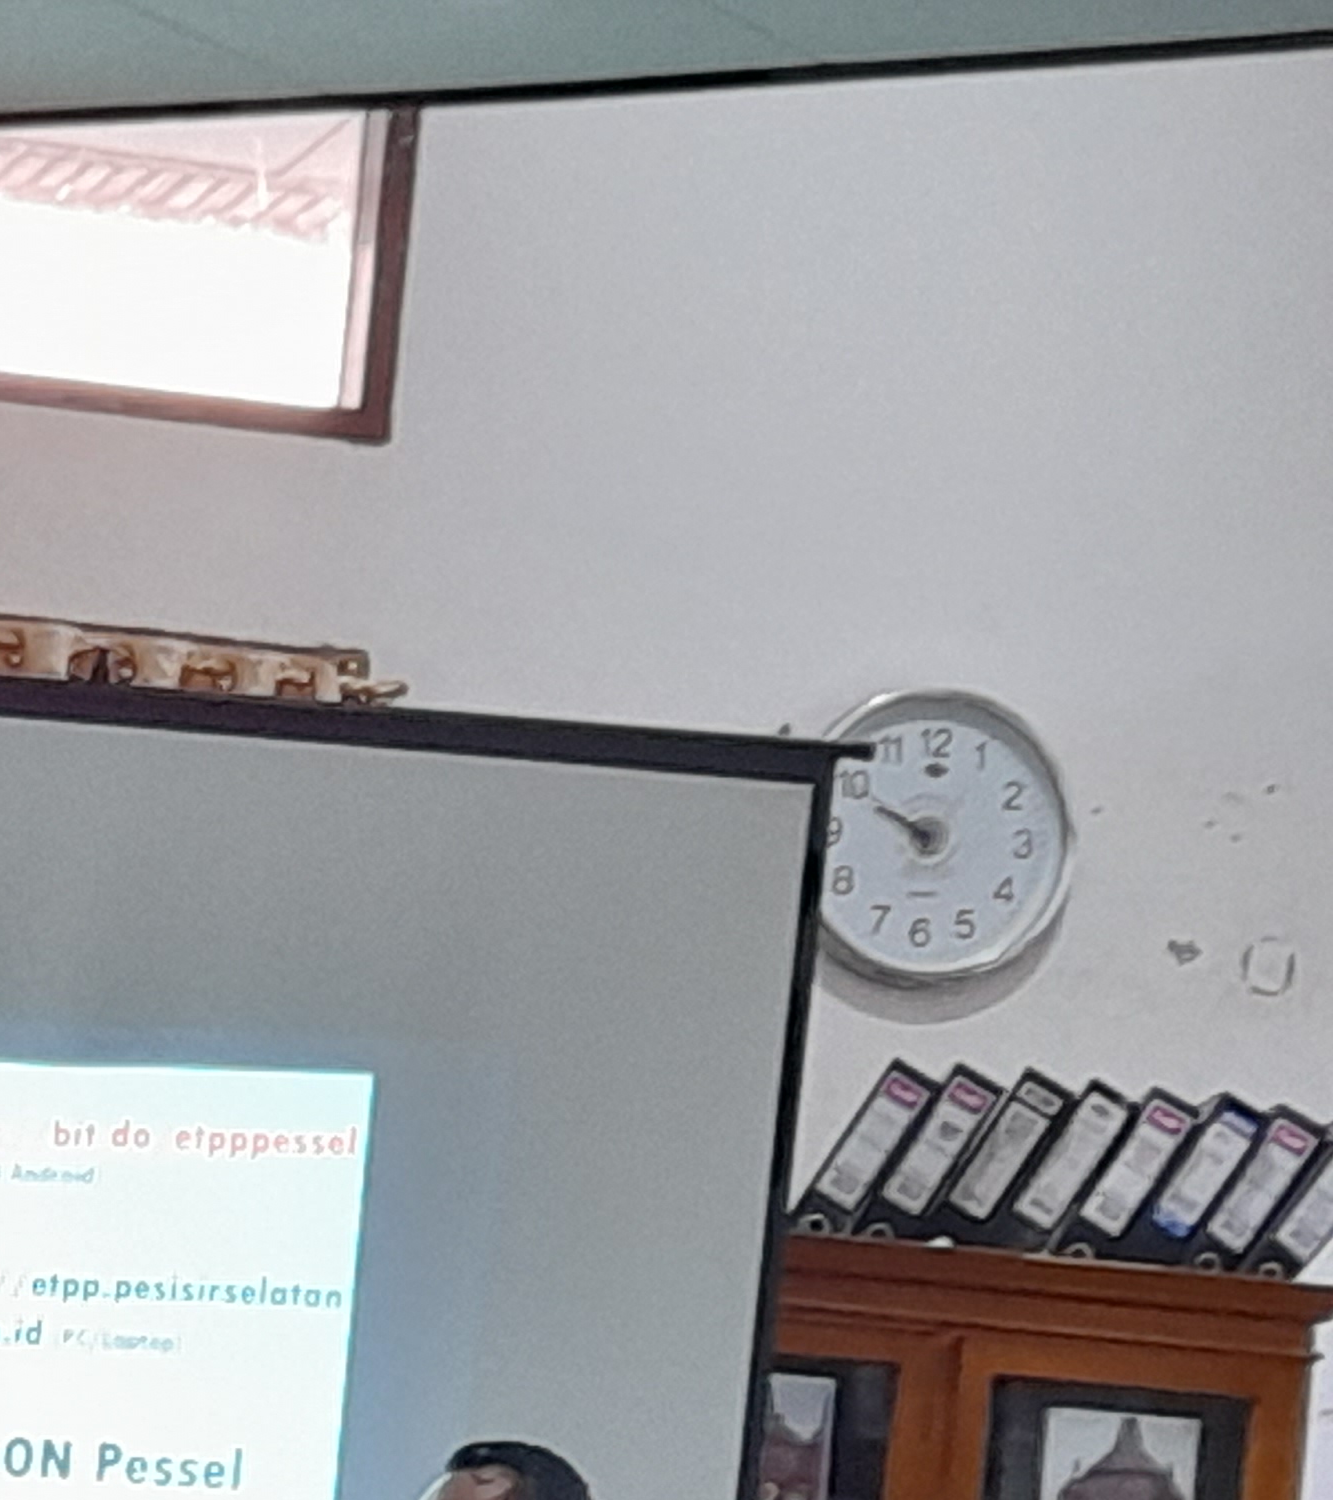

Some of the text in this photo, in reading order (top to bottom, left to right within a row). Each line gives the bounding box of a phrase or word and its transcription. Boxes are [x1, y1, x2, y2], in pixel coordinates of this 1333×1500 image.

[879, 736, 903, 766] 11
[921, 728, 953, 758] 12
[975, 740, 987, 770] 1
[838, 769, 869, 800] 10
[1002, 781, 1025, 811] 2
[1013, 828, 1032, 860] 3
[832, 865, 854, 896] 8
[993, 876, 1015, 902] 4
[870, 905, 891, 935] 7
[908, 917, 932, 948] 6
[954, 909, 976, 940] 5
[96, 1441, 243, 1491] Pessel
